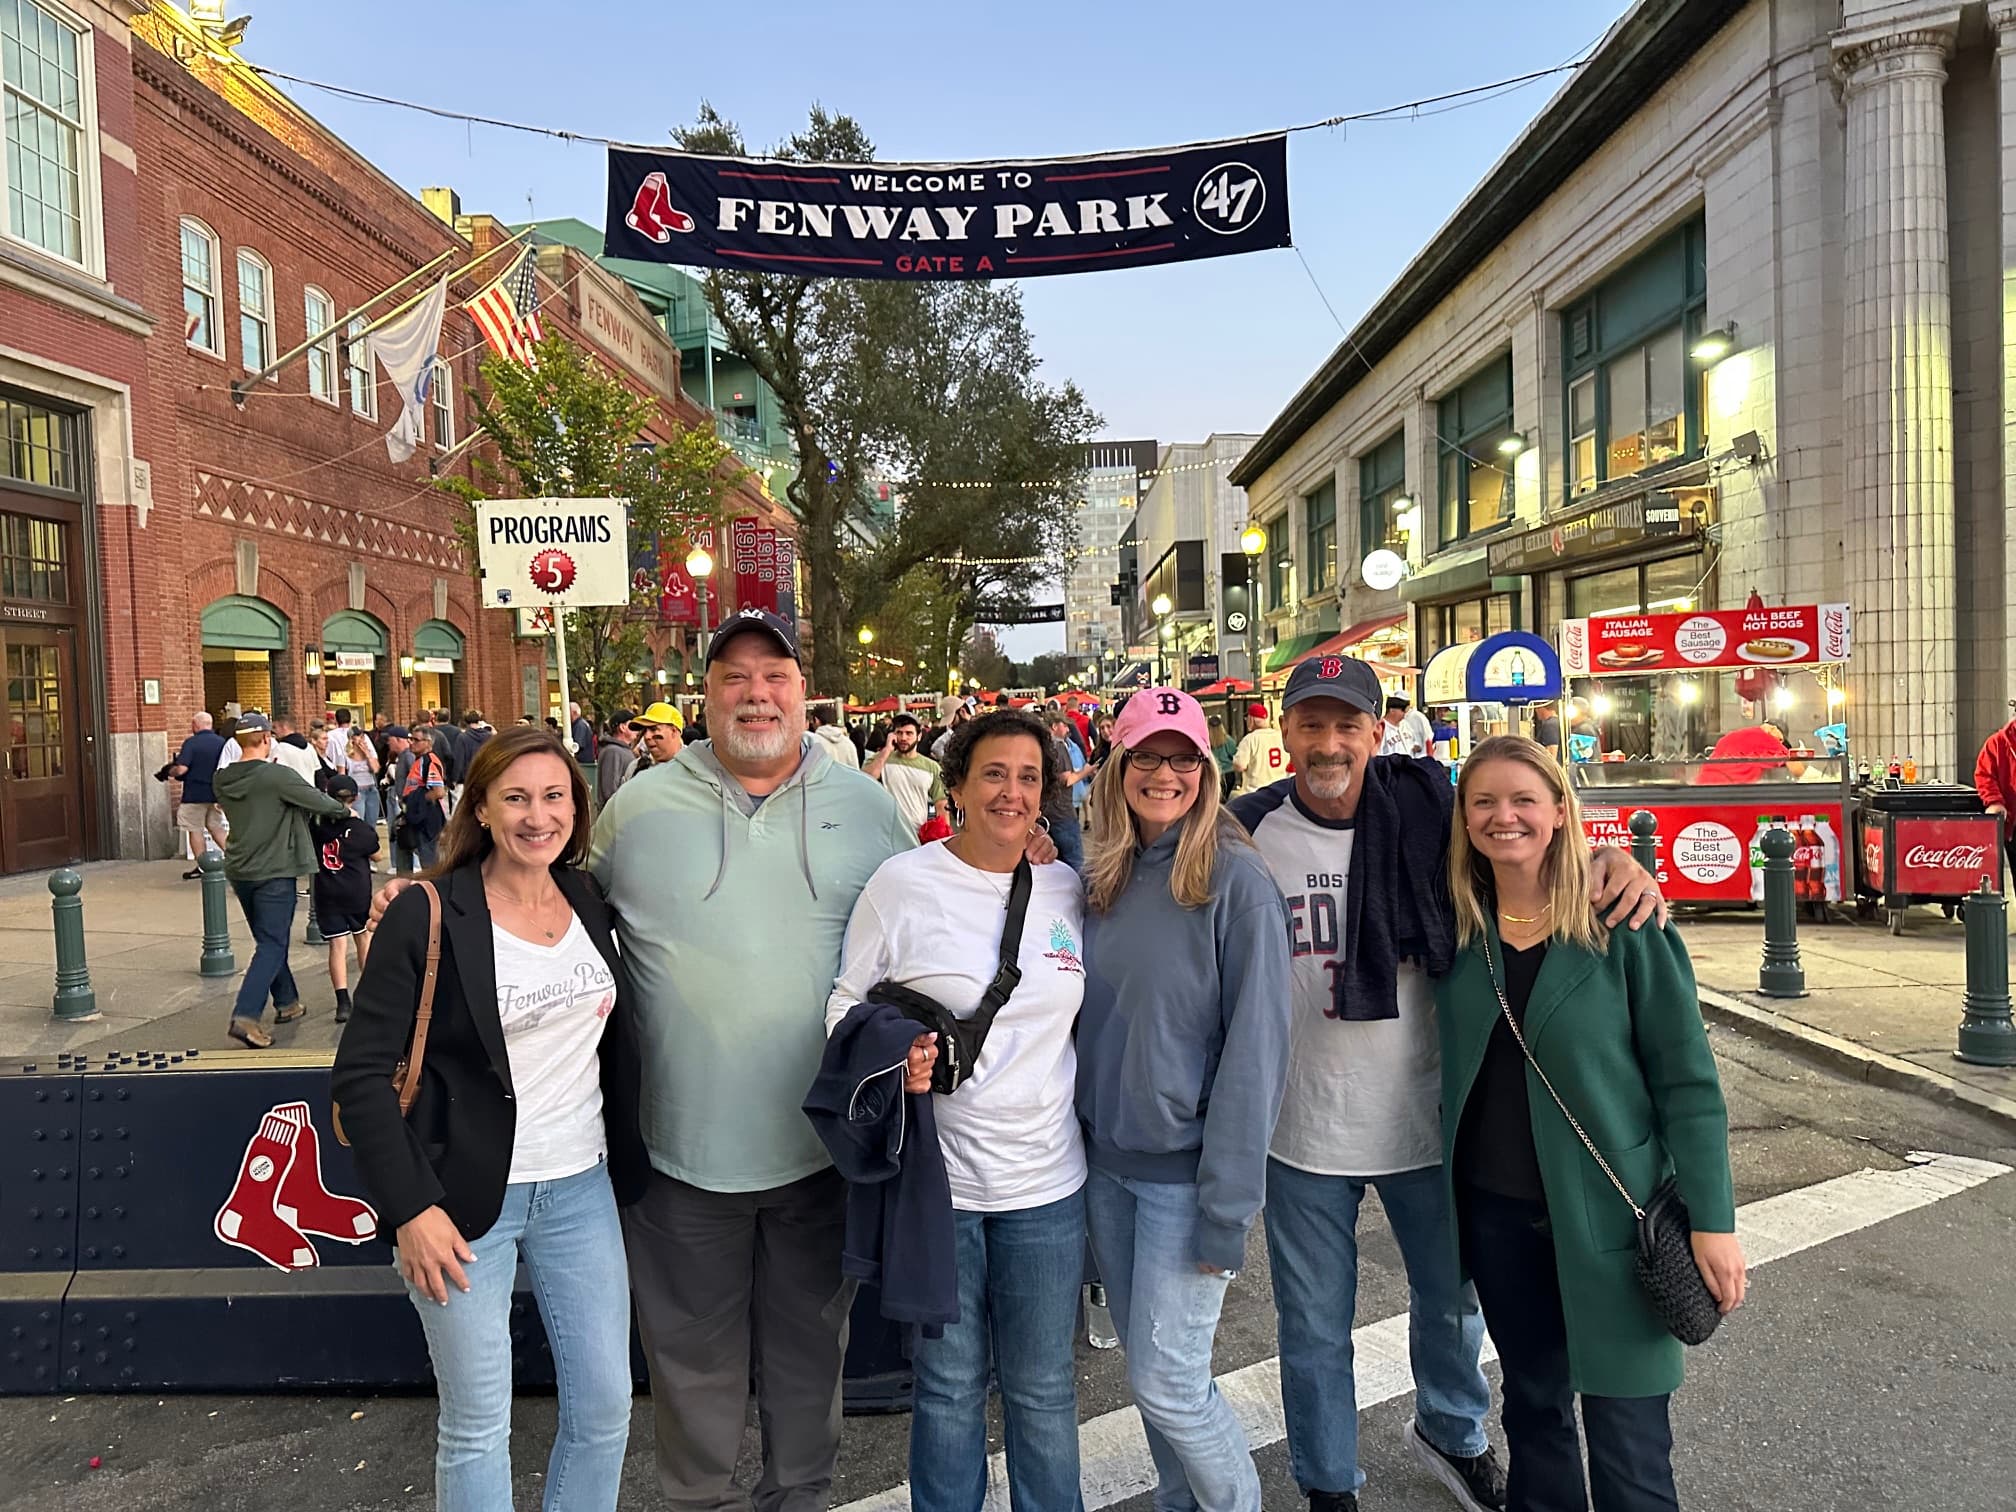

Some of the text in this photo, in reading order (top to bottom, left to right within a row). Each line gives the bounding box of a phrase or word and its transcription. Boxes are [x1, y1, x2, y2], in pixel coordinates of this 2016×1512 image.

[851, 173, 1032, 193] WELCOME TO
[717, 192, 1175, 242] FENWAY PARK
[895, 254, 994, 273] GATE A
[587, 294, 666, 382] FENWAY PARK
[1645, 508, 1680, 524] SOUVENIR
[489, 514, 611, 545] PROGRAMS
[735, 520, 758, 576] 1916
[757, 531, 776, 582] 1918
[774, 541, 795, 594] 1946
[3, 606, 47, 620] STREET
[1745, 610, 1801, 622] ALL BEEF
[1604, 620, 1649, 630] ITALIAN
[1691, 620, 1709, 628] The
[1742, 620, 1804, 631] HOT DOGS
[1601, 627, 1654, 639] SAUSAGE
[1690, 631, 1711, 640] Best
[1824, 608, 1843, 657] Coca-Cola
[1680, 639, 1721, 648] Sausage
[1317, 656, 1344, 680] B
[1156, 693, 1181, 715] B
[1268, 747, 1281, 768] 8
[1694, 827, 1718, 838] The
[1586, 836, 1664, 848] SAUSE
[1693, 841, 1721, 852] Best
[1680, 851, 1734, 864] Sausage
[1905, 844, 1989, 869] Coca-Cola
[1306, 873, 1349, 888] BOS
[1697, 867, 1719, 878] Co.
[496, 962, 614, 1018] Fenway Par
